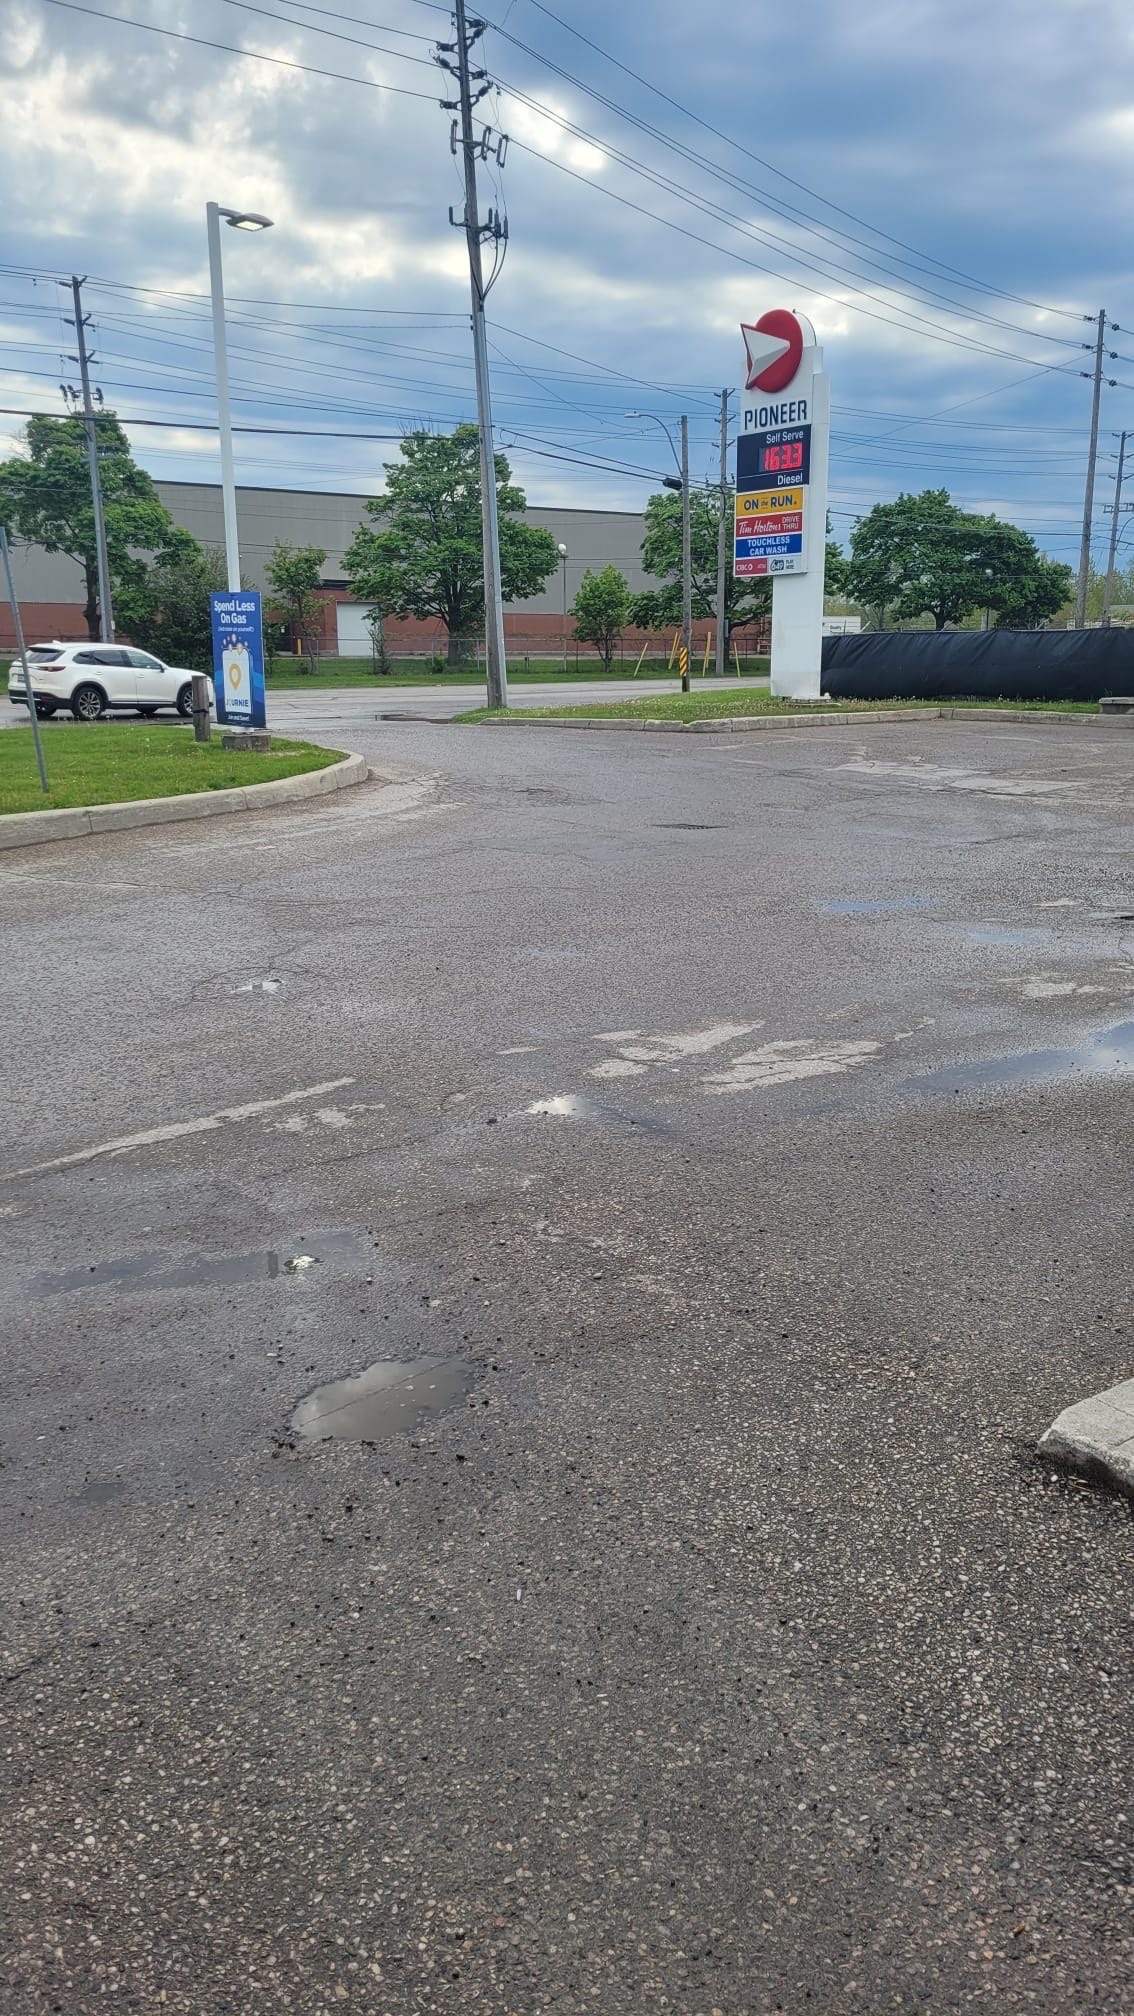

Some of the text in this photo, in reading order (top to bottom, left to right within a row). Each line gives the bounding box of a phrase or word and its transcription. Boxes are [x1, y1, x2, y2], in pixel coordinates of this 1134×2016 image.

[744, 400, 807, 430] PIONEER
[766, 430, 804, 444] Self Serve
[778, 472, 802, 485] Diesel
[744, 498, 758, 510] ON
[739, 520, 781, 534] Tim Hortons
[747, 536, 790, 547] TOUCHLESS
[750, 546, 787, 556] CAR WASH
[214, 600, 255, 613] Spend Less
[221, 613, 247, 624] On Gas
